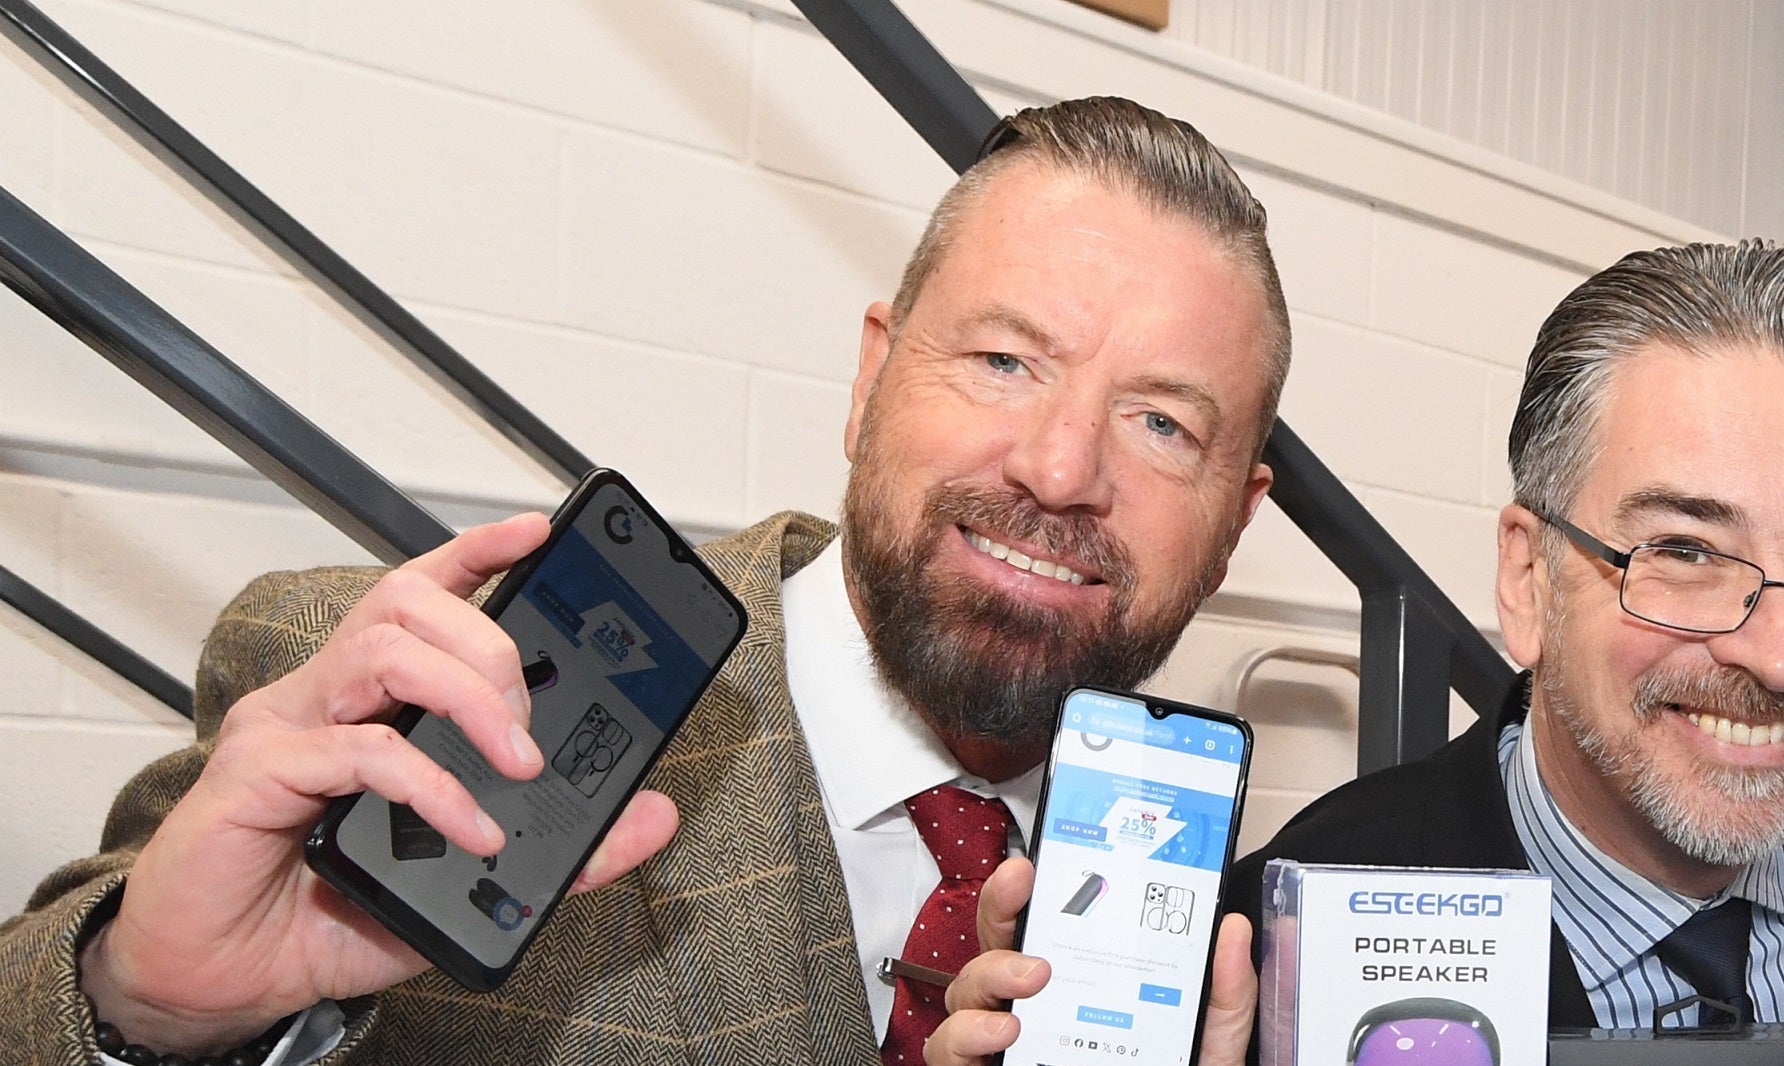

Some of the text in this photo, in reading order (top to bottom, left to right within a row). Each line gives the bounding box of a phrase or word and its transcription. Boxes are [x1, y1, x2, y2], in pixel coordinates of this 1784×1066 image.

[1120, 817, 1156, 835] 25%
[1348, 890, 1503, 917] ESEEKGO
[1355, 936, 1497, 956] PORTABLE
[1362, 964, 1489, 984] SPEAKER
